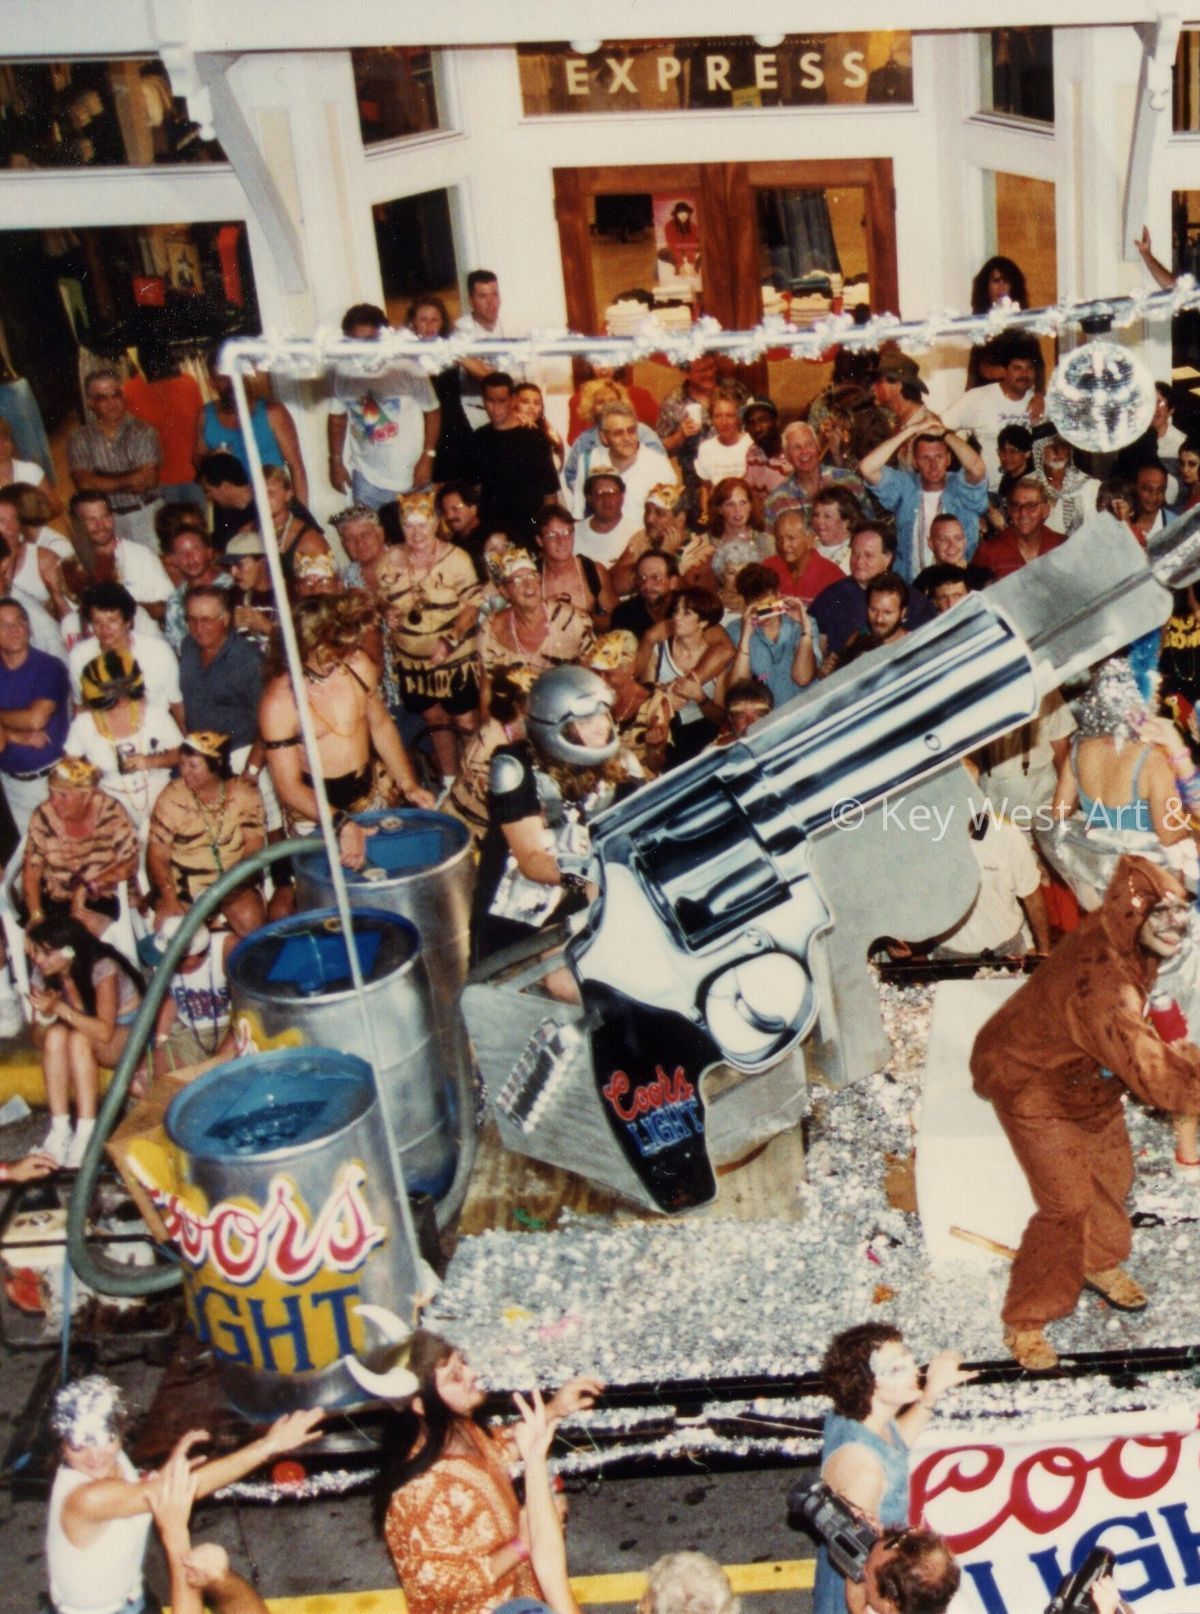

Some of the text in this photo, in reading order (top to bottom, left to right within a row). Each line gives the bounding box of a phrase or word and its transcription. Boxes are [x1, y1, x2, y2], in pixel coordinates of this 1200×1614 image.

[565, 51, 868, 95] EXPRESS
[602, 1064, 694, 1121] Coors
[627, 1097, 705, 1157] LIGHT
[140, 1163, 386, 1285] oors
[187, 1284, 361, 1374] GHT
